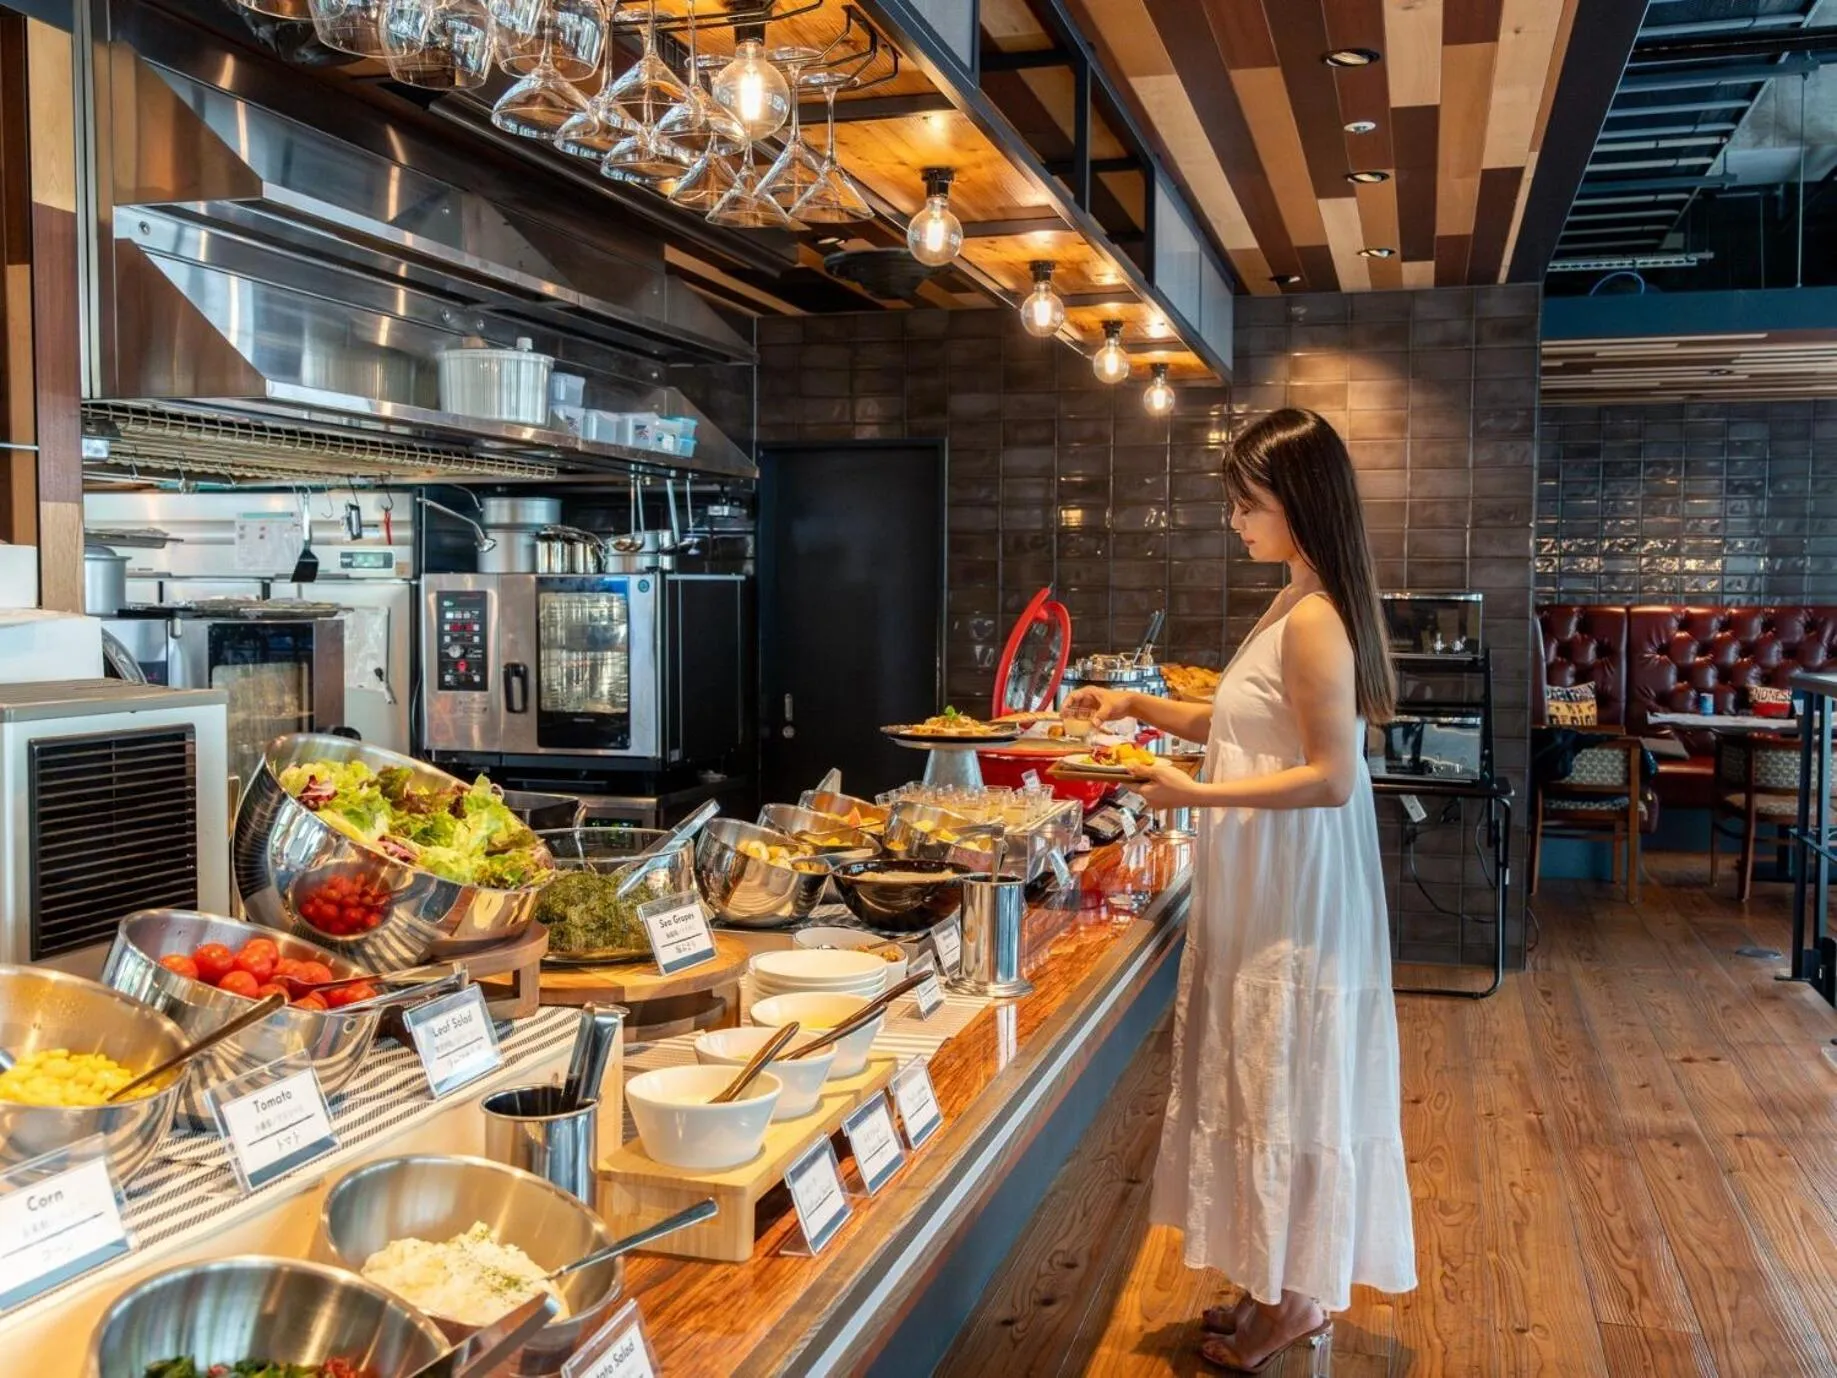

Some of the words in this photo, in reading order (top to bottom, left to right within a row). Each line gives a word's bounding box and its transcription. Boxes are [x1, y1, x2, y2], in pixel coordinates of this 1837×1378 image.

[659, 919, 672, 928] Sea
[673, 913, 694, 924] Grapes
[433, 1021, 451, 1037] Leaf
[453, 1010, 472, 1028] Salad
[253, 1090, 292, 1113] Tomato
[27, 1190, 64, 1212] Corn
[613, 1338, 634, 1366] Salad
